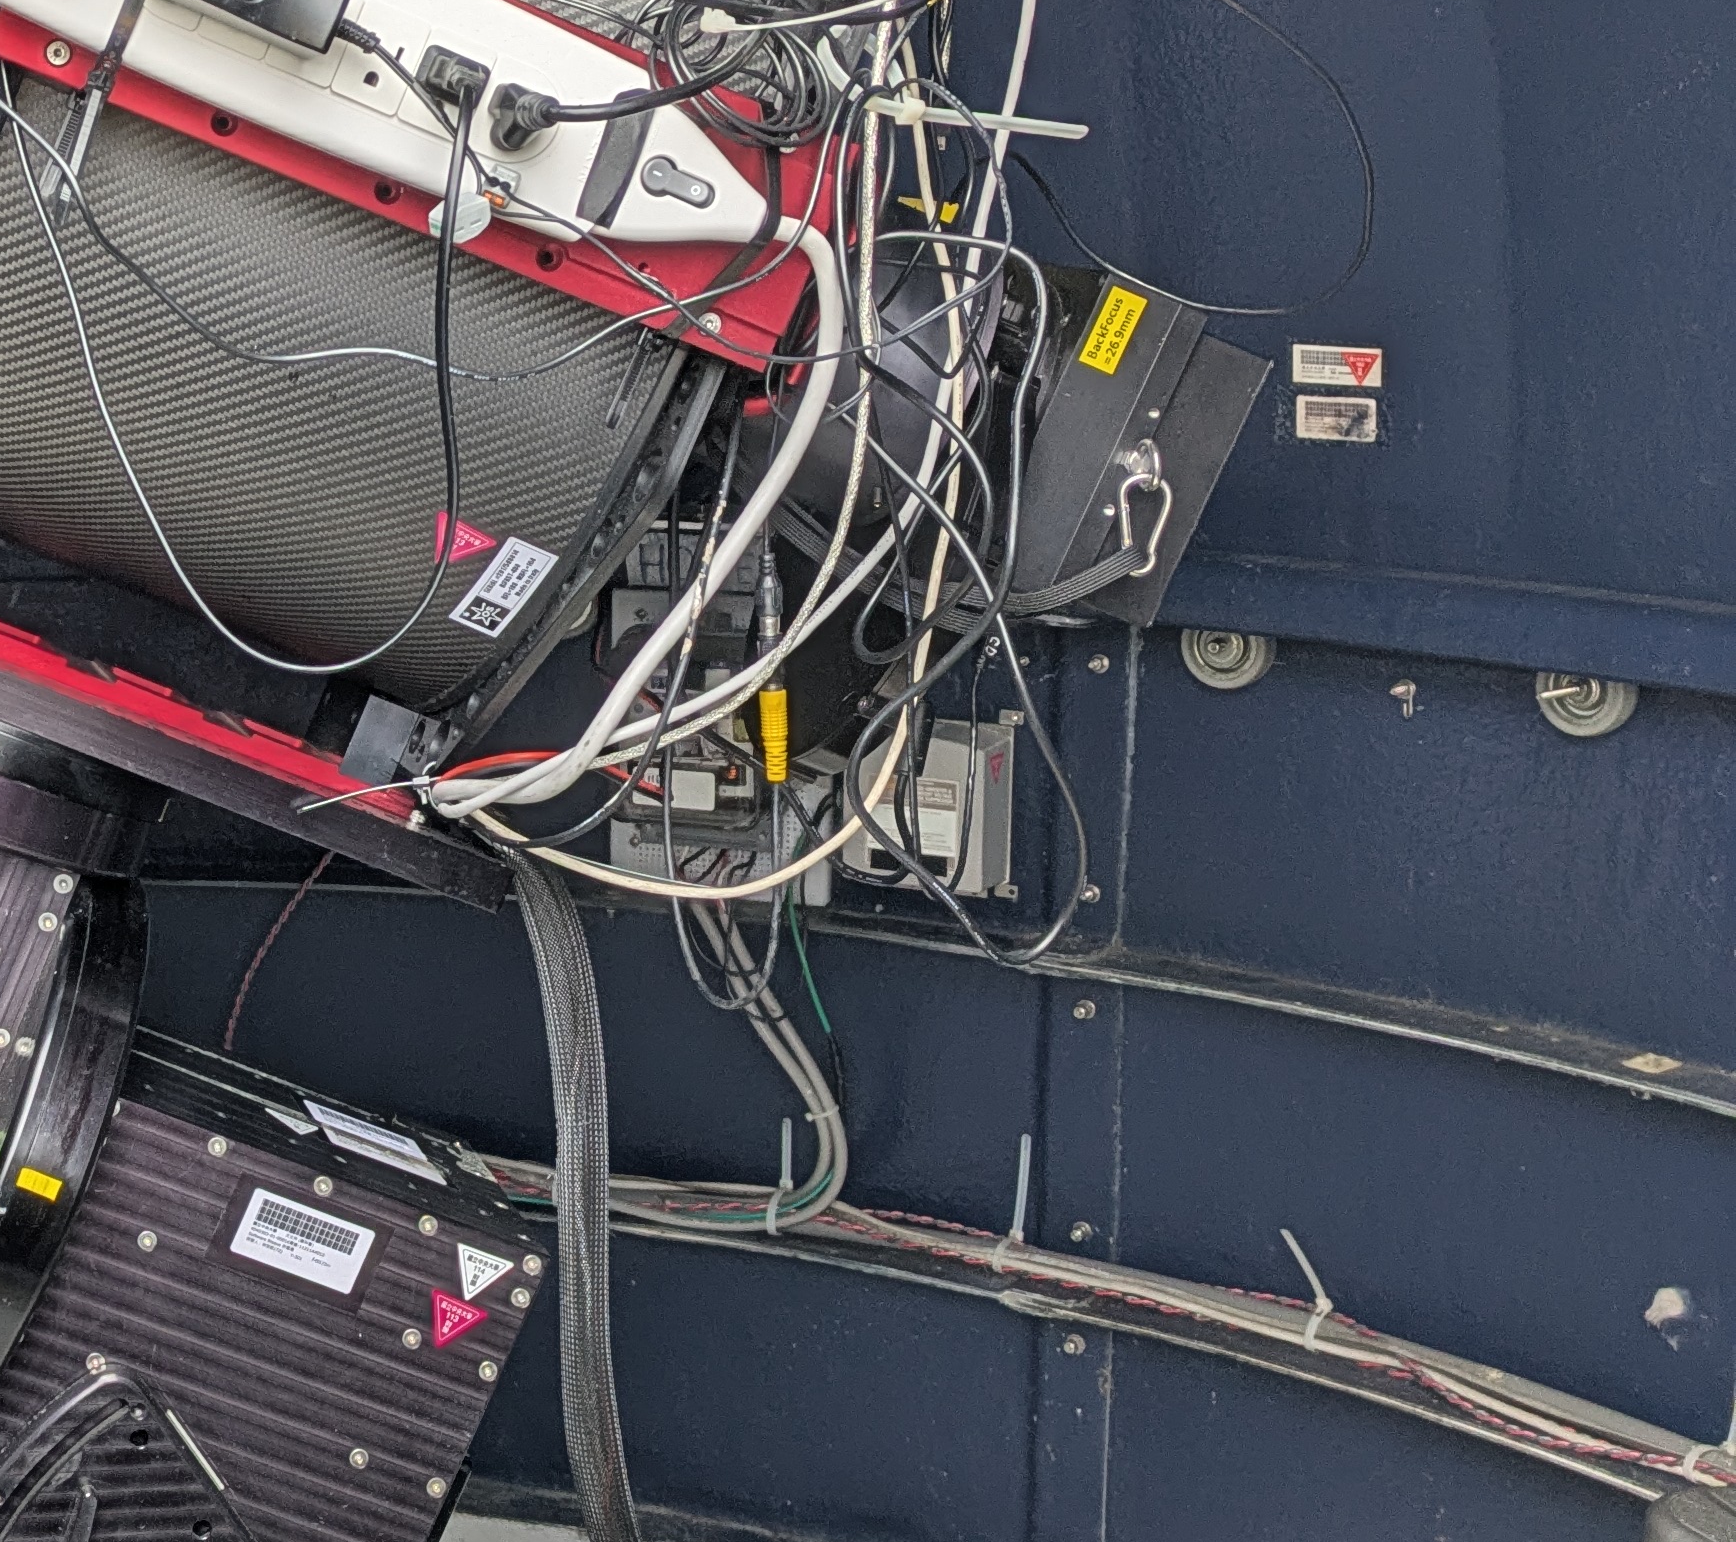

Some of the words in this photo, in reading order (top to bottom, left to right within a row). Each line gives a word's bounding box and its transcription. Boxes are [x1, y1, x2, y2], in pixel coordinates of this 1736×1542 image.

[1086, 297, 1124, 360] BackFocus
[1104, 308, 1137, 365] =26.9mm
[473, 1265, 486, 1275] 114
[446, 1311, 460, 1323] 113
